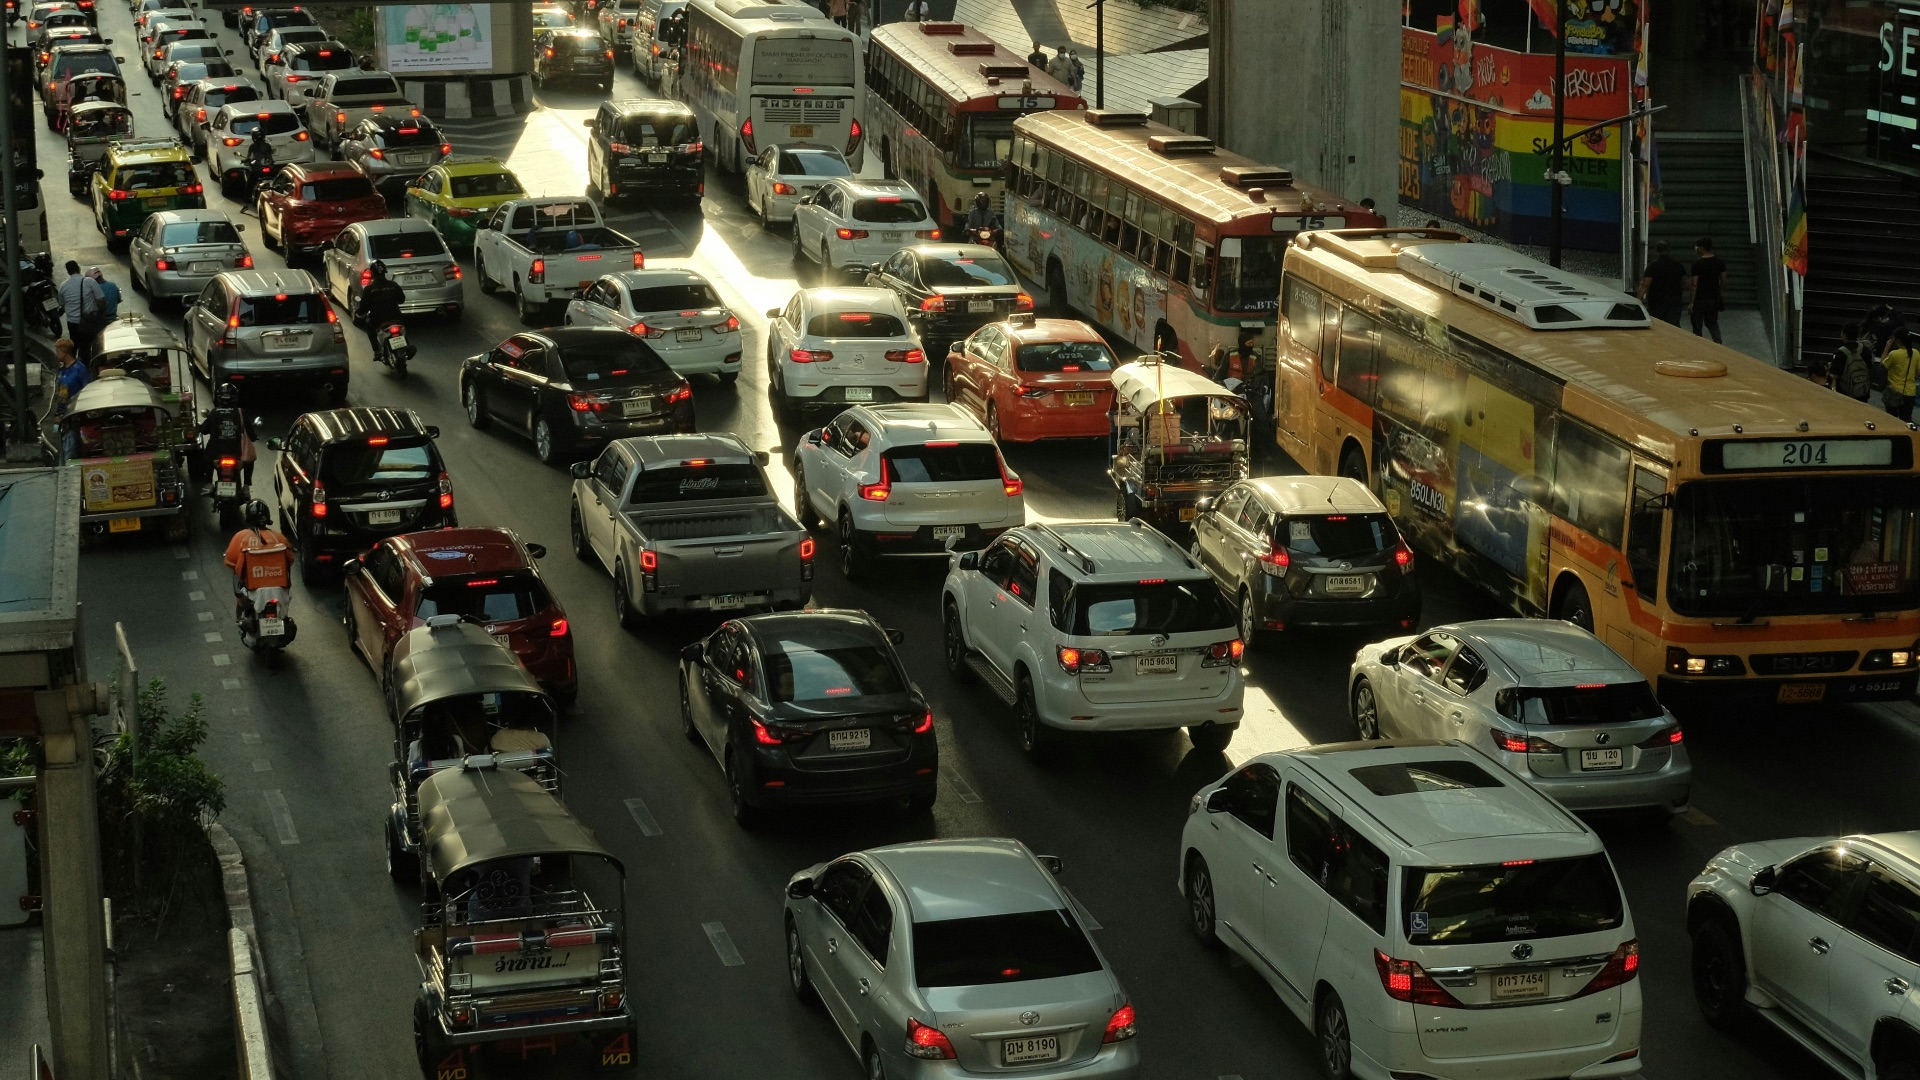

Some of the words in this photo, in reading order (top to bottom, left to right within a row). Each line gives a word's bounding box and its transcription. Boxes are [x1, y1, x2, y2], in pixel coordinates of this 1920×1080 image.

[1878, 22, 1919, 77] SE
[1549, 66, 1616, 97] DERSCITY
[1017, 97, 1038, 108] 15
[1532, 138, 1573, 156] SIM
[1296, 216, 1325, 230] 15
[1783, 443, 1828, 464] 204
[1410, 479, 1447, 514] 850LN3L
[384, 510, 400, 518] 8090
[1156, 657, 1175, 665] 9636
[1773, 656, 1834, 670] ISUZU
[849, 730, 869, 739] 9215
[1604, 750, 1618, 759] 120
[1520, 974, 1543, 985] 7454
[1028, 1038, 1056, 1052] 8190
